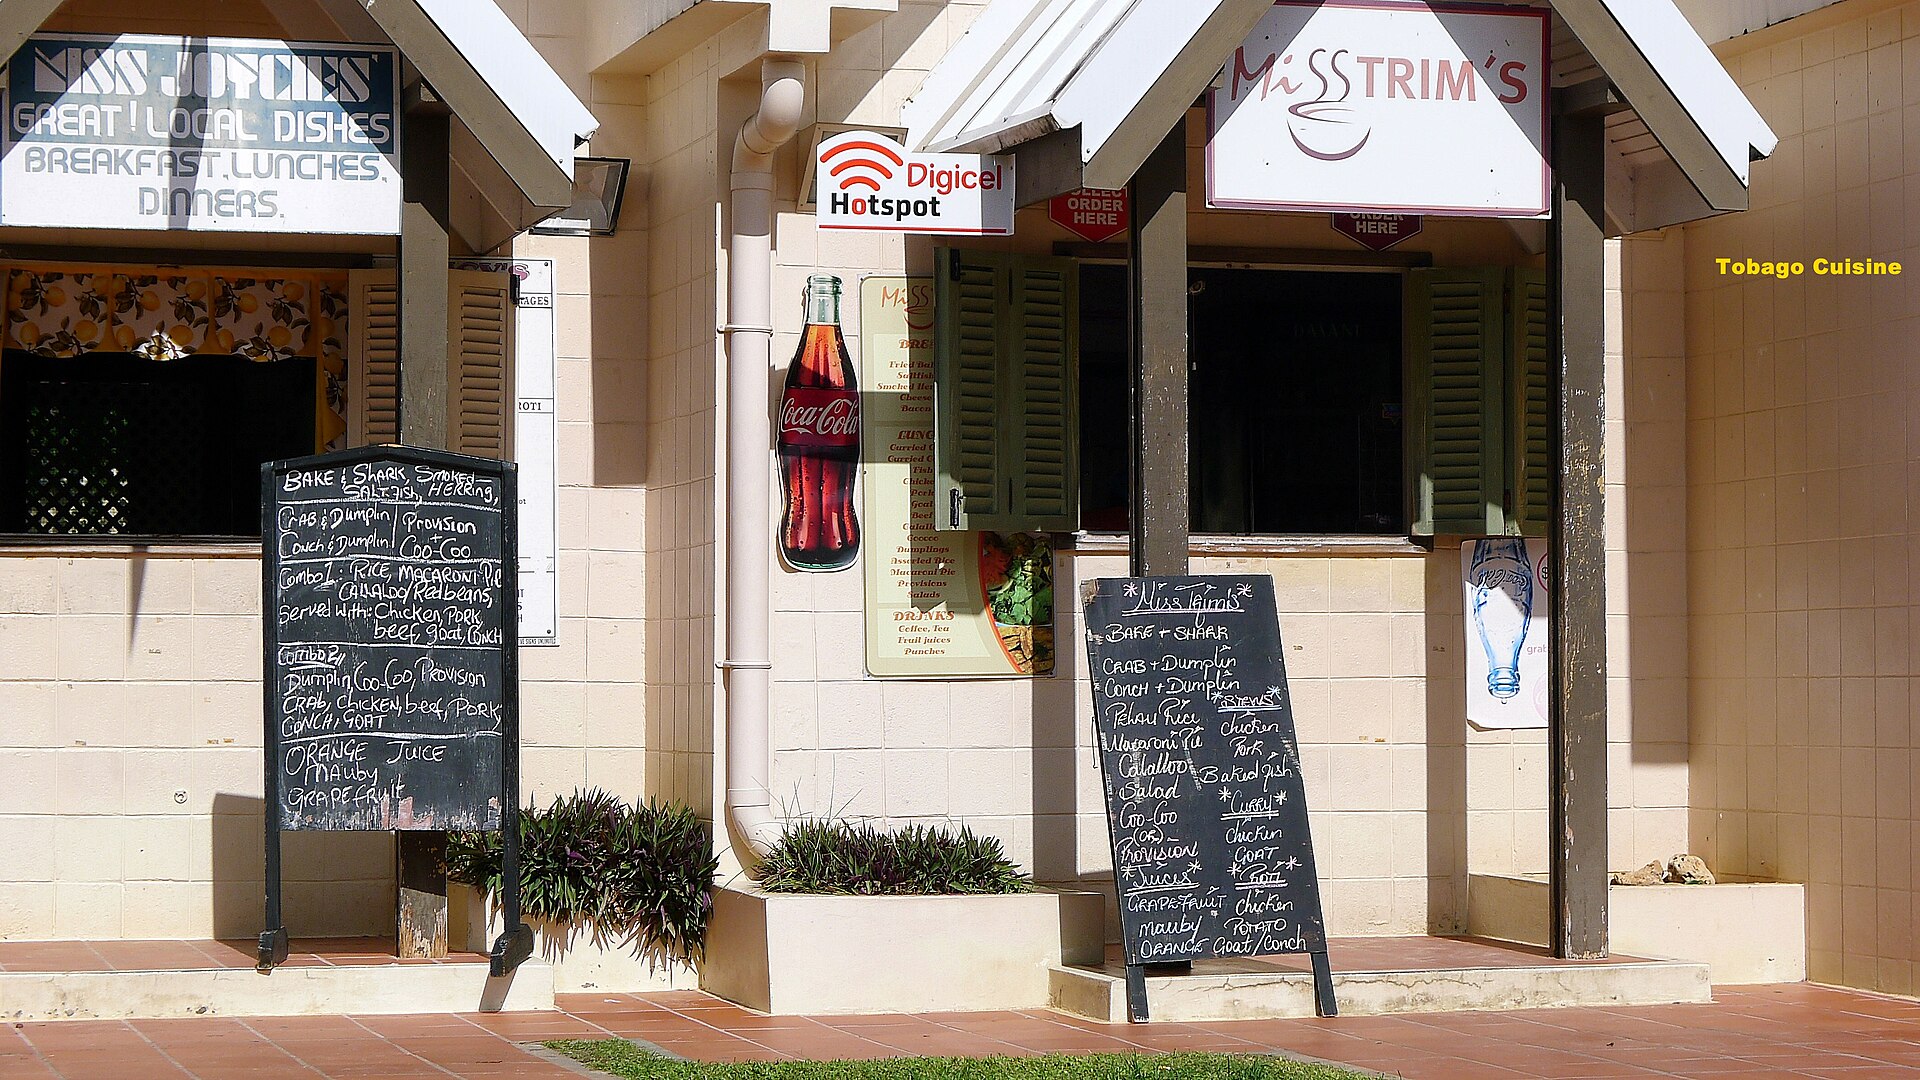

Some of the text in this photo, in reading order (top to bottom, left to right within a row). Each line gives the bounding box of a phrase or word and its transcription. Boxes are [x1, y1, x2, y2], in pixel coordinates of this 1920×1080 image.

[34, 47, 148, 96] MISS
[146, 106, 258, 142] LOCAL
[274, 110, 390, 144] DISHES
[907, 163, 1001, 195] Digicel
[138, 186, 285, 218] DINNERS.
[830, 193, 941, 221] Hotspot
[1067, 198, 1123, 211] ORDER
[1073, 212, 1118, 225] HERE
[1355, 221, 1398, 234] HERE
[889, 360, 915, 368] Fried
[877, 382, 915, 390] Smoked
[900, 393, 933, 401] Cheese
[901, 404, 932, 412] Bacon
[781, 398, 859, 435] Coca-Cola
[897, 430, 934, 440] LUNC
[890, 443, 926, 451] Curried
[913, 466, 933, 474] Fish
[282, 470, 335, 492] BAKE
[903, 477, 935, 485] Chicke
[911, 500, 934, 509] Goat
[896, 546, 950, 554] Dumplings
[890, 556, 956, 565] Assorted Rice
[890, 568, 956, 576] Macaroni Pie
[907, 591, 941, 599] Salads
[893, 611, 955, 621] DRINKS
[1105, 623, 1156, 643] BAKE
[1173, 624, 1229, 641] SHARK
[1102, 657, 1147, 676] CRAB
[285, 738, 369, 776] ORANGE
[1199, 760, 1259, 783] Baked
[1118, 774, 1181, 800] Salad
[1234, 845, 1280, 866] GOAT
